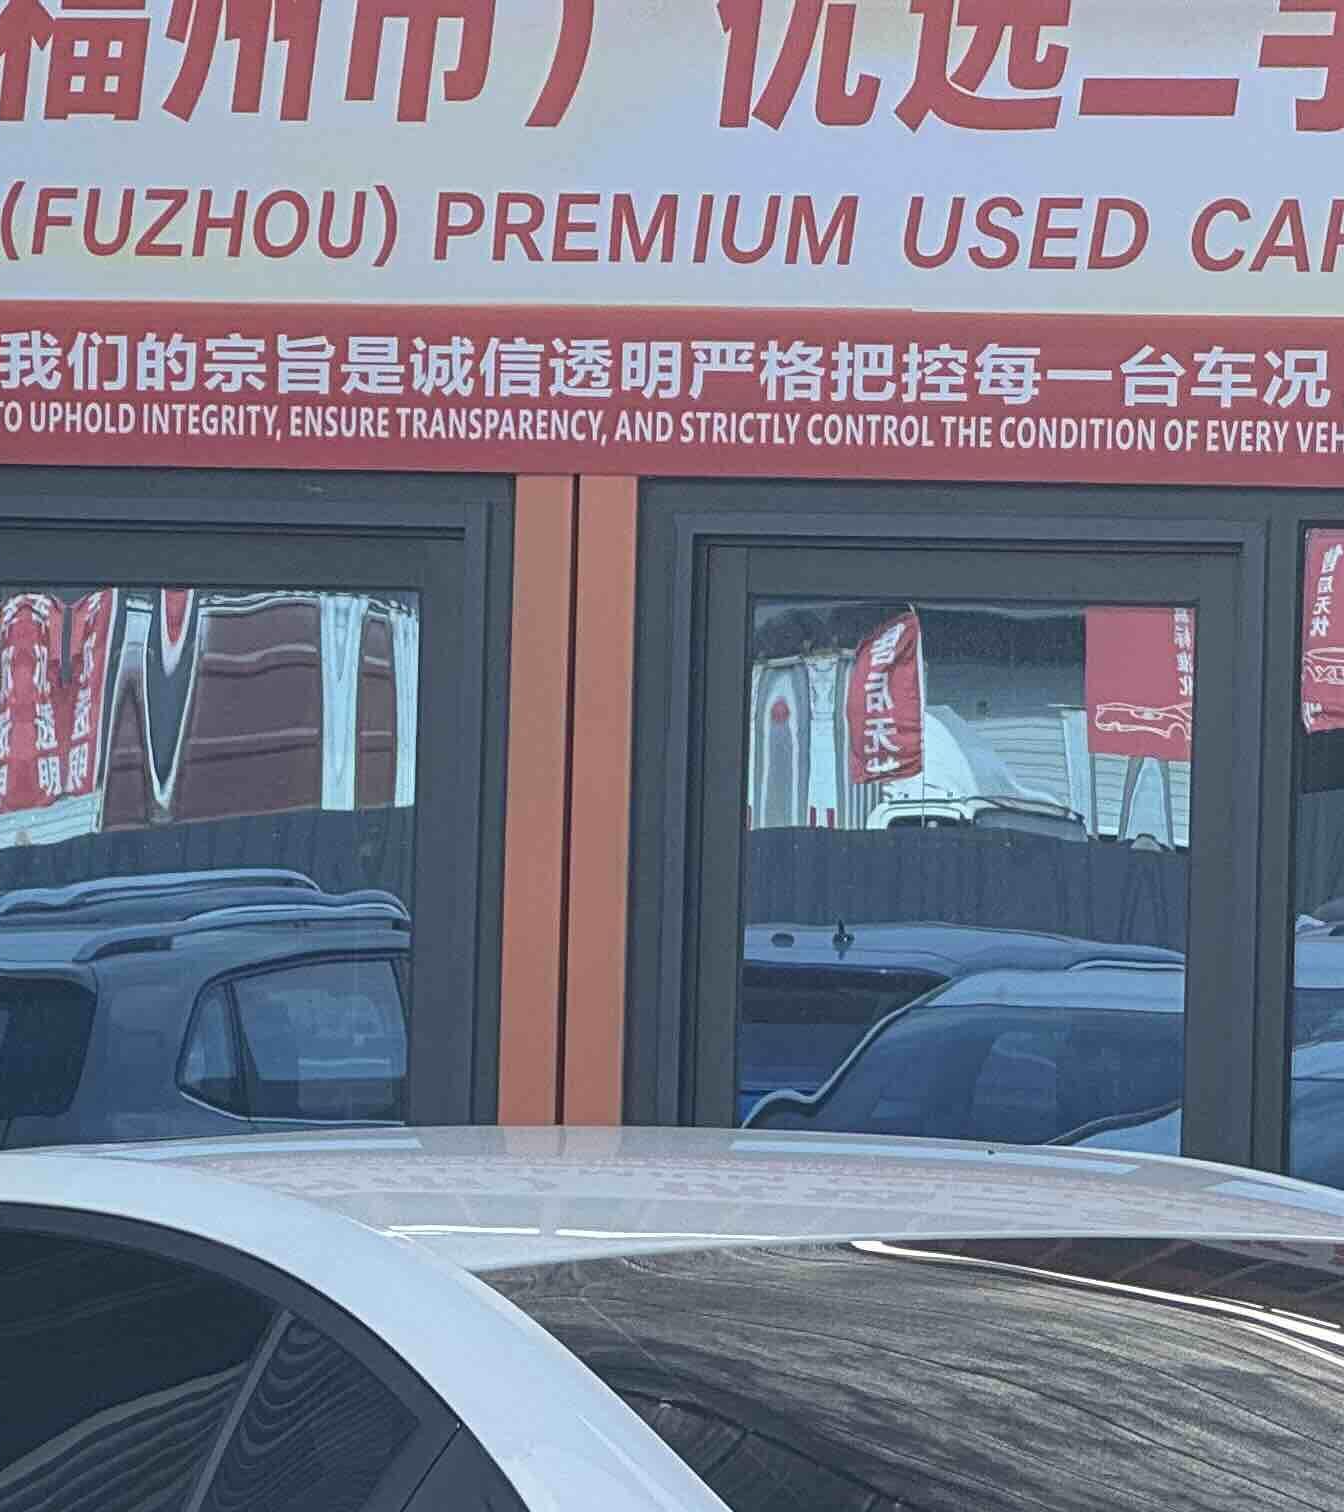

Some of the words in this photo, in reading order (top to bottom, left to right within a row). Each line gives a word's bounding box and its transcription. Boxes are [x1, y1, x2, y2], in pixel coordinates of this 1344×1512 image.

[0, 180, 398, 267] (FUZHOU)
[433, 192, 859, 266] PREMIUM
[903, 196, 1150, 271] USED
[30, 402, 136, 435] UPHOLD
[143, 404, 282, 441] INTEGRITY,
[290, 406, 389, 439] ENSURE
[396, 407, 608, 446] TRANSPARENCY,
[614, 411, 674, 443] AND
[680, 411, 801, 446] STRICTLY
[808, 414, 934, 449] CONTROL
[941, 416, 993, 449] THE
[1000, 417, 1156, 452] CONDITION
[1164, 419, 1198, 452] OF
[1206, 420, 1289, 454] EVERY
